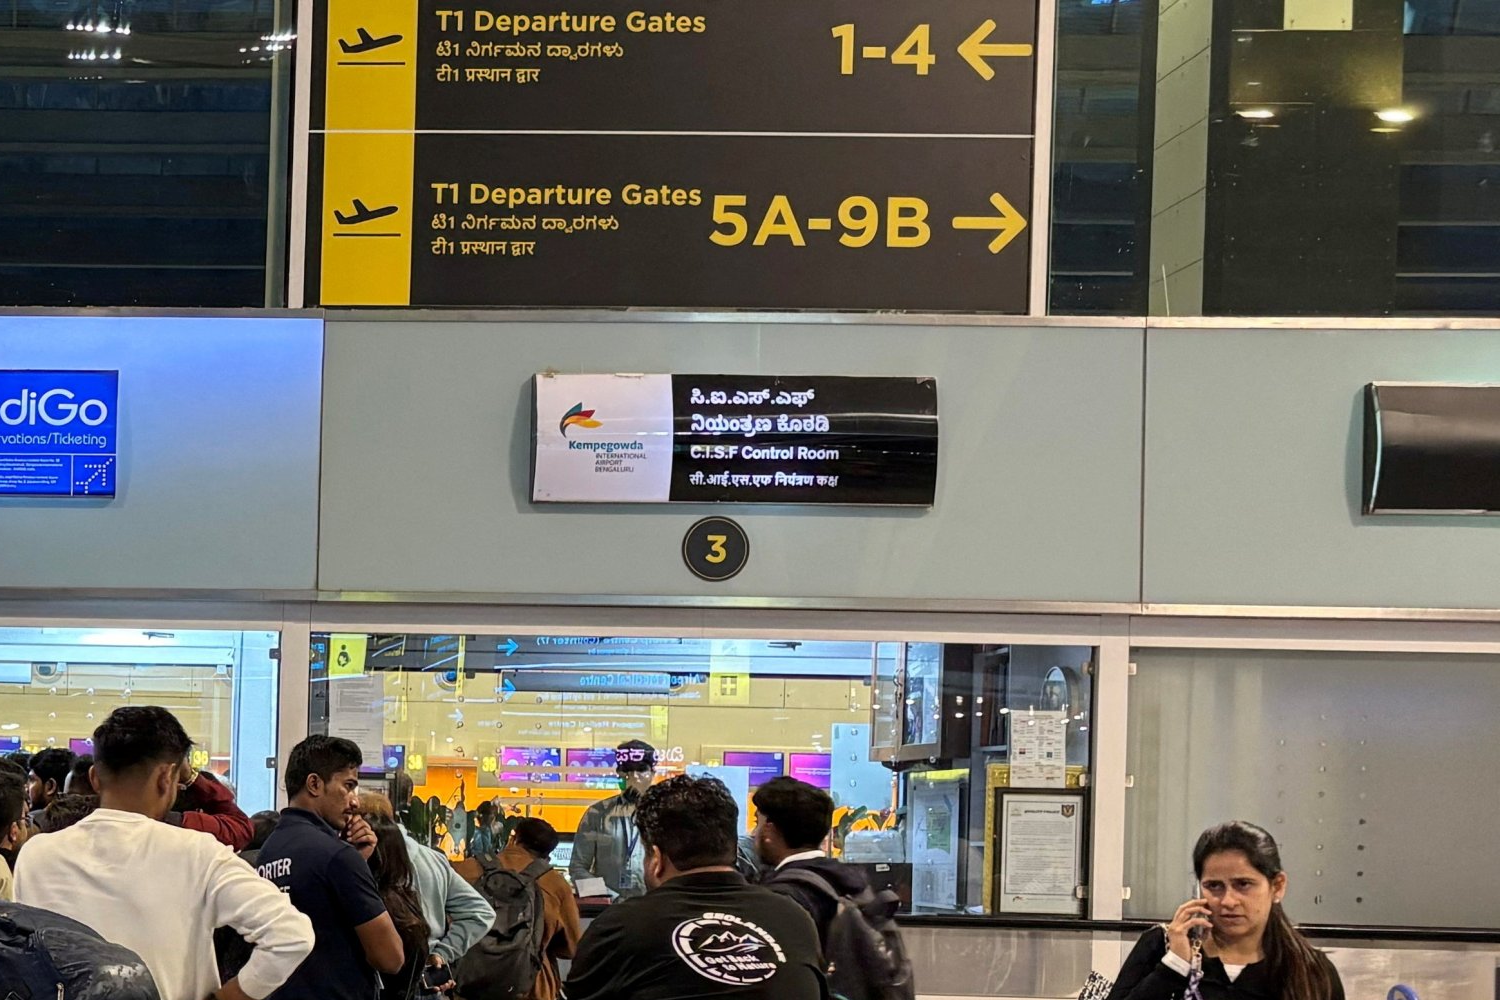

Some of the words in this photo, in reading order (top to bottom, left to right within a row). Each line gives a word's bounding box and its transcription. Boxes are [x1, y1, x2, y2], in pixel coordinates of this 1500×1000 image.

[435, 10, 465, 32] T1
[474, 10, 616, 36] Departure
[625, 10, 707, 33] Gates
[465, 41, 542, 57] ನಿರ್ಗಮನ
[546, 41, 624, 61] ದ್ವಾರಗಳು
[831, 23, 936, 76] 1-4
[435, 63, 460, 82] टी1
[465, 67, 512, 83] प्रस्थान
[515, 67, 541, 84] द्वार
[431, 183, 459, 205] T1
[469, 183, 612, 209] Departure
[621, 183, 702, 206] Gates
[461, 213, 537, 230] ನಿರ್ಗಮನ
[541, 214, 620, 234] ದ್ವಾರಗಳು
[708, 194, 931, 248] 5A-9B
[431, 236, 455, 255] टी1
[460, 240, 507, 256] प्रस्थान
[510, 240, 536, 257] द्वार
[691, 413, 772, 437] ನಿಯಂತ್ರಣ
[776, 413, 830, 432] ಕೊಠಡಿ
[568, 440, 644, 453] Kempegowda
[690, 445, 739, 459] C.I.S.F
[741, 445, 794, 460] Control
[797, 446, 840, 460] Room
[775, 471, 814, 487] नियंत्रण
[816, 474, 839, 487] कक्ष
[705, 534, 727, 563] 3
[256, 857, 292, 880] ORTER
